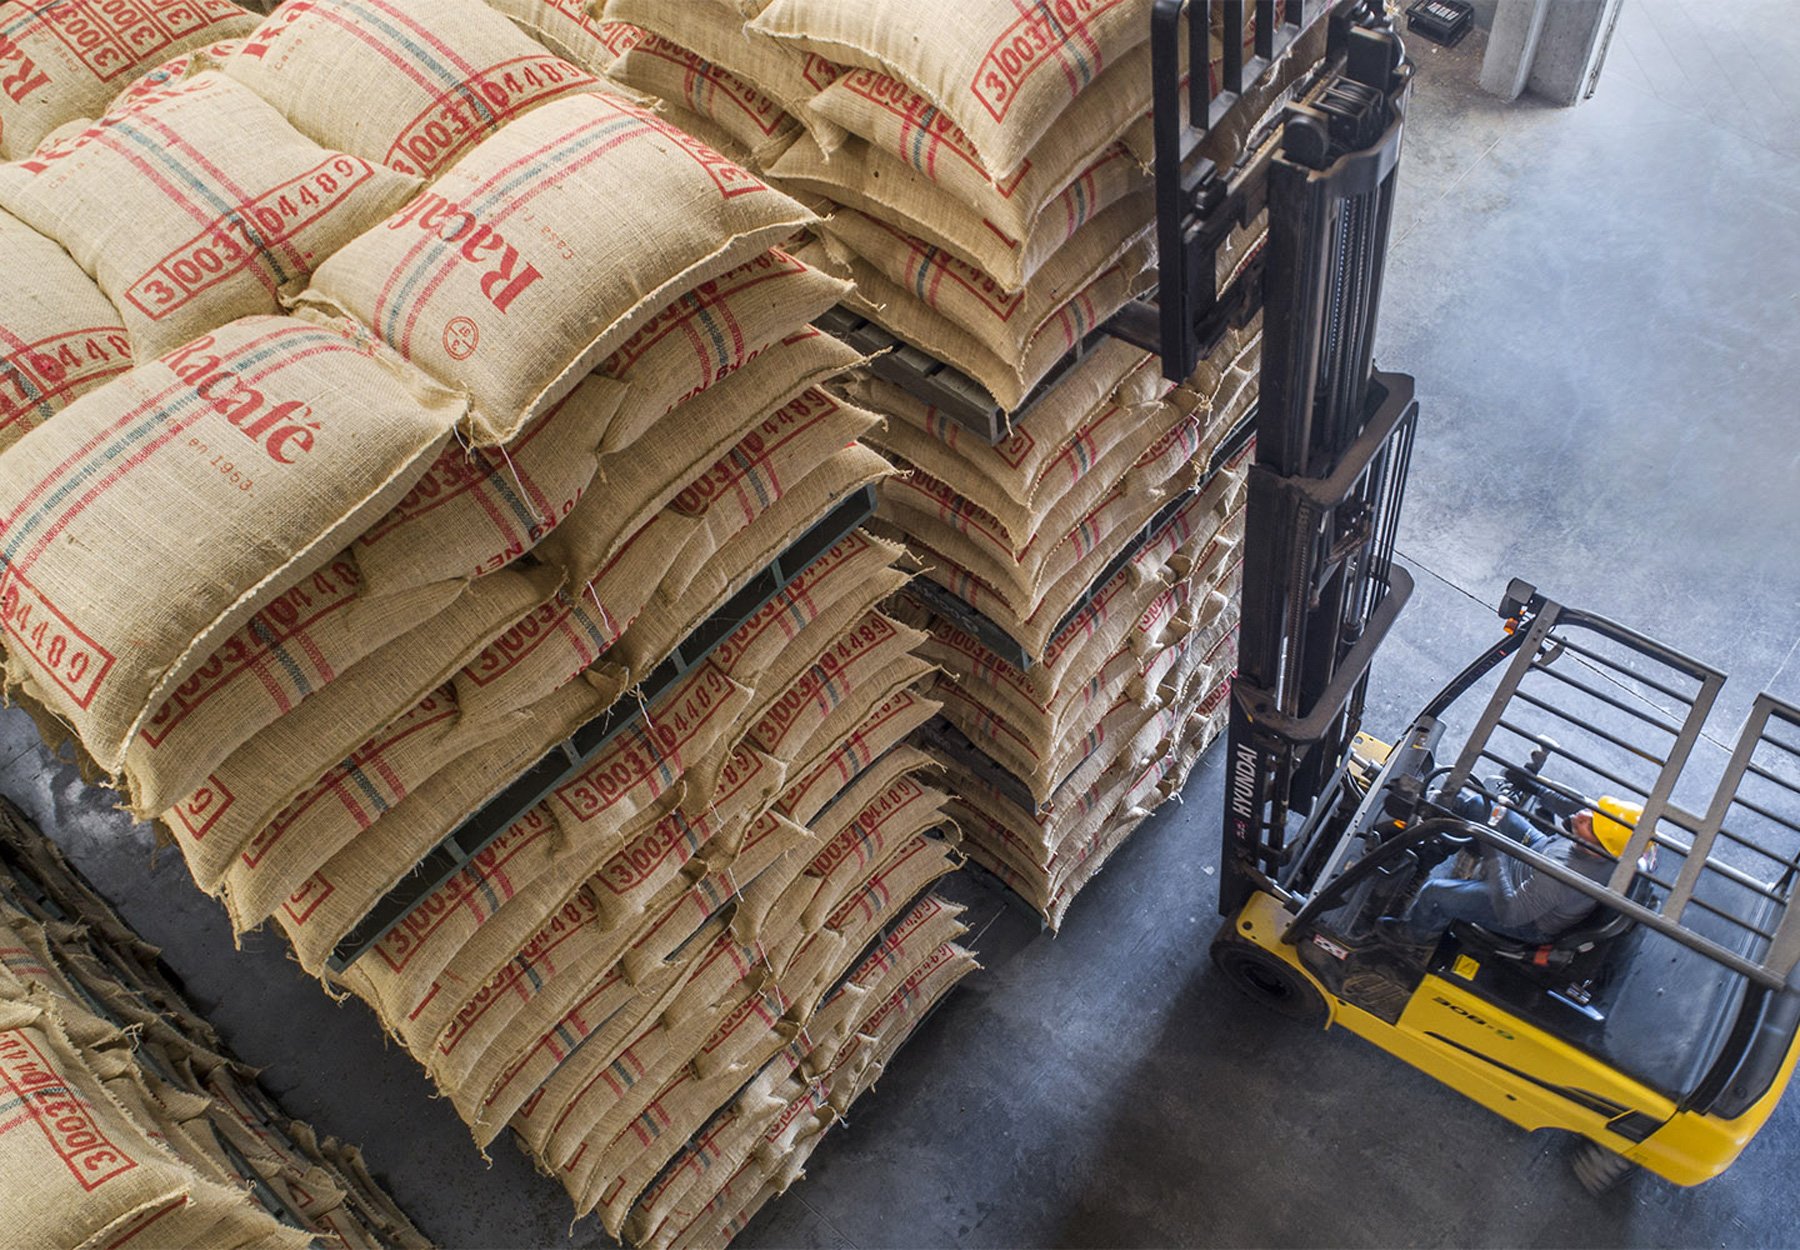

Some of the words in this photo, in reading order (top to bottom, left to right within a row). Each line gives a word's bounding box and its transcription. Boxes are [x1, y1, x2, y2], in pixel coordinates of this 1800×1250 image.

[131, 26, 155, 45] 3
[167, 8, 194, 27] 3
[94, 48, 119, 67] 3
[857, 71, 873, 86] 3
[985, 71, 1007, 102] 3
[1000, 14, 1057, 76] 0037
[409, 100, 479, 160] 0037
[482, 60, 578, 105] 04489
[144, 280, 174, 304] 3
[174, 220, 250, 284] 0037
[254, 160, 353, 233] 04489
[389, 192, 541, 314] Racaf
[758, 721, 778, 742] 3
[821, 619, 887, 673] 04489
[574, 787, 598, 809] 3
[598, 745, 654, 795] 0037
[658, 673, 720, 747] 04489
[1232, 742, 1257, 818] HYUNDAI
[612, 865, 632, 884] 3
[38, 1092, 94, 1149] 0037
[84, 1150, 117, 1170] 3
